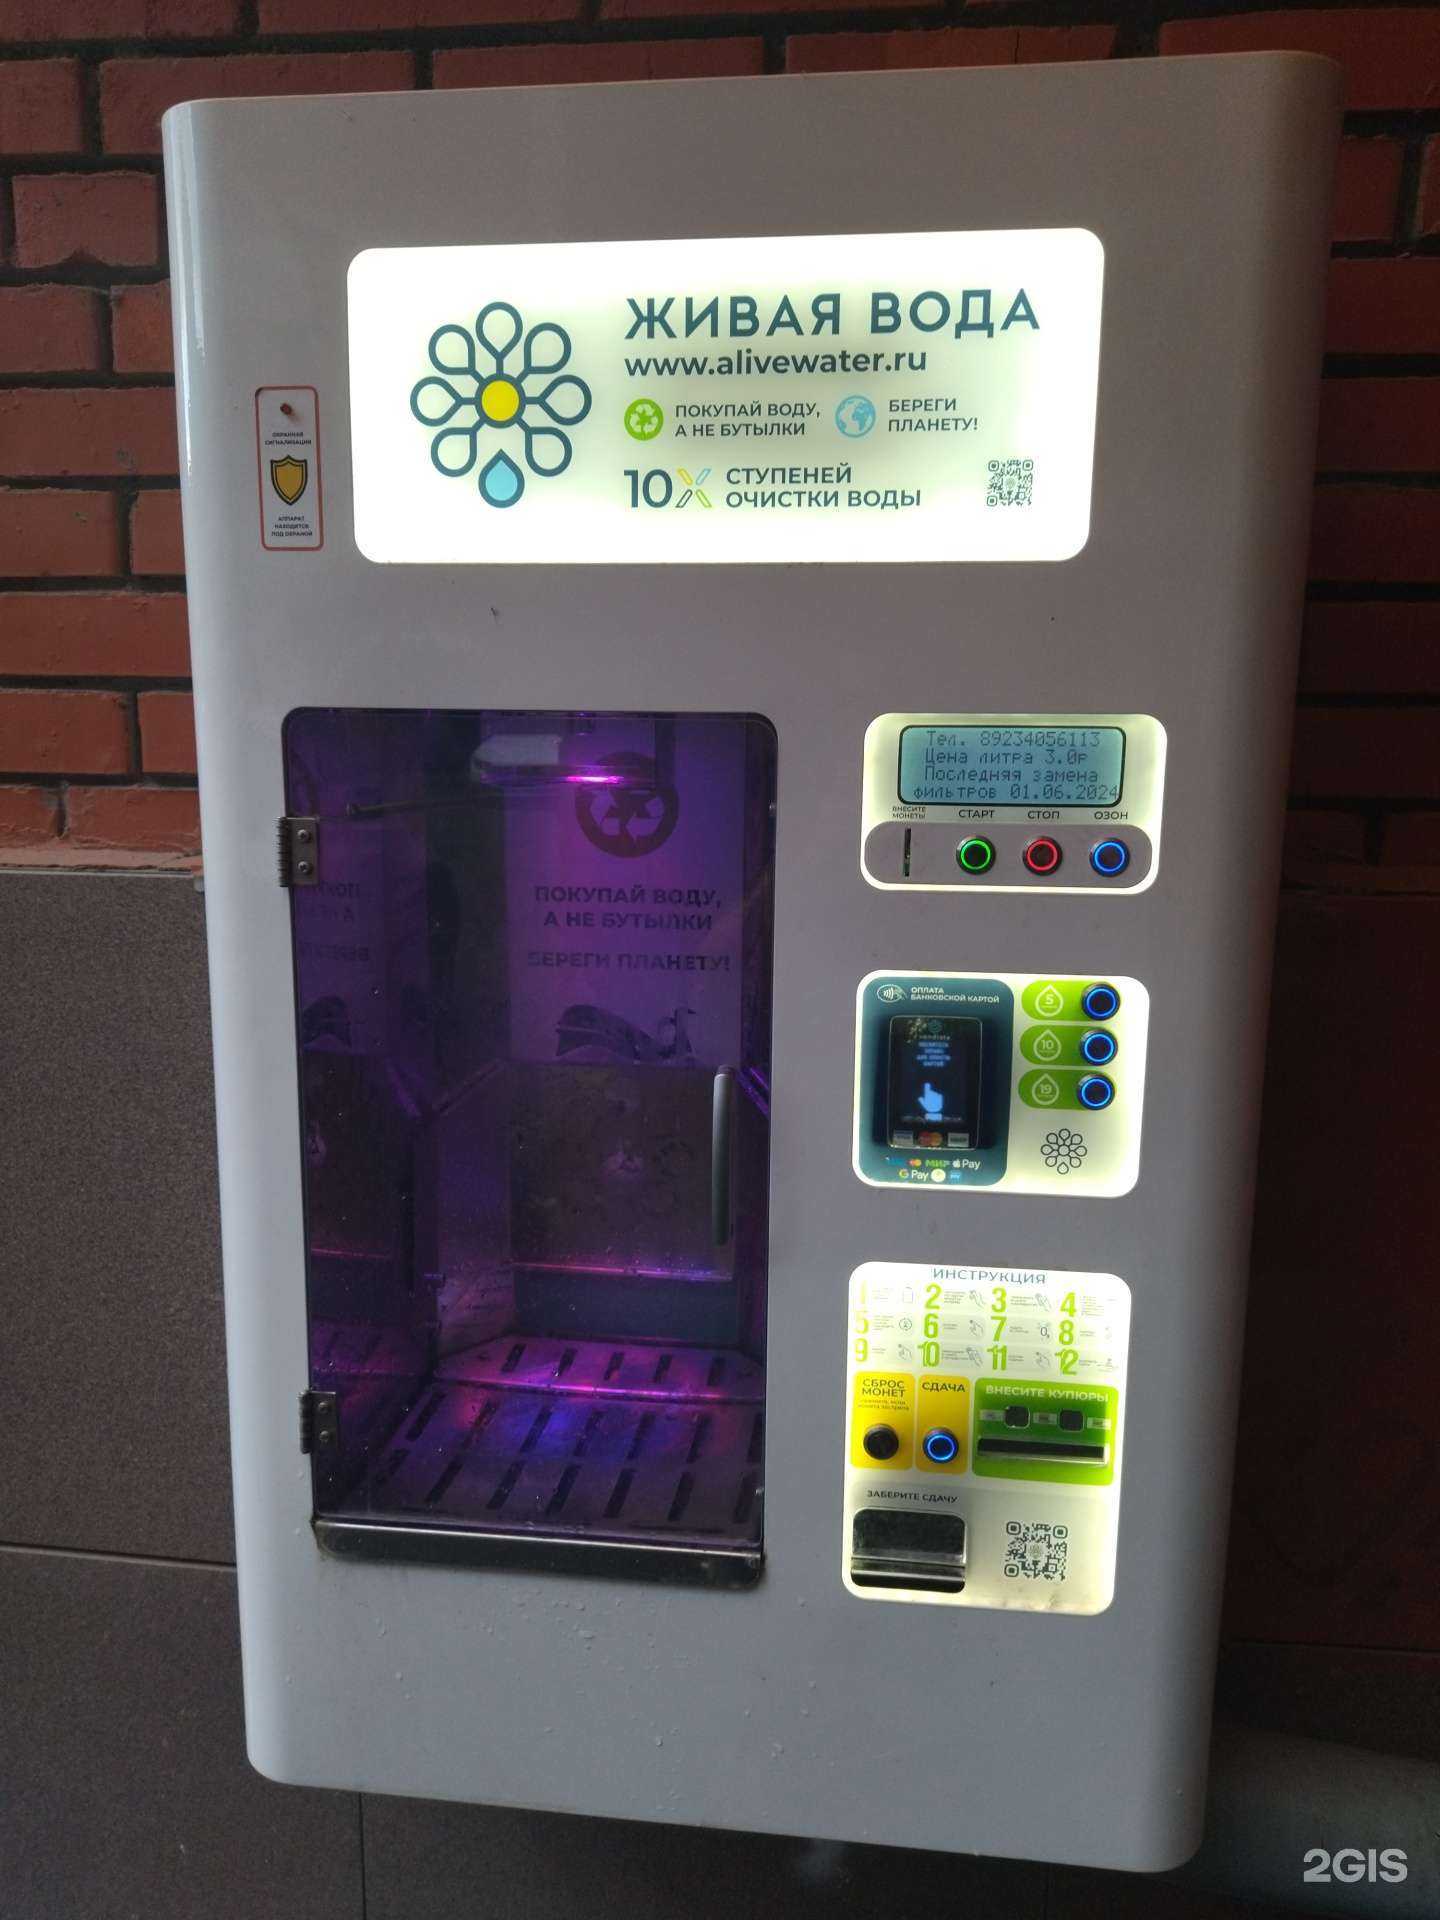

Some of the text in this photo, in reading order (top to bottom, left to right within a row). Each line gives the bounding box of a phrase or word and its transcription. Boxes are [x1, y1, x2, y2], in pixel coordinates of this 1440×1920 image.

[624, 287, 1040, 340] ЖИВАЯ ВОДА
[624, 347, 927, 377] www.alivewater.ru
[675, 400, 820, 419] ПОКУПАЙ ВОДУ,
[889, 398, 957, 413] БЕРЕГИ
[675, 422, 806, 438] А НЕ БУТЫЛКИ
[888, 417, 978, 433] ПЛАНЕТУ!
[726, 463, 852, 485] СТУПЕНЕЙ
[726, 489, 922, 509] ОЧИСТКИ ВОДЫ
[927, 730, 1101, 748] Тел. 89234056113
[925, 749, 968, 765] Цена
[979, 751, 1033, 765] литра
[924, 766, 1098, 782] Последняя замена
[913, 785, 1118, 801] фильтров 01.06.2024
[958, 809, 995, 819] СТАРТ
[1027, 810, 1060, 820] СТОП
[1094, 811, 1129, 820] ОЗОН
[534, 884, 722, 909] ПОКУПАЙ ВОДУ,
[544, 910, 713, 931] А НЕ БУТЫЛКИ
[528, 950, 731, 972] БЕРЕГИ ПЛАНЕТУ!
[911, 986, 944, 994] ОПЛАТА
[910, 993, 1000, 1004] БАНКОВСКОЙ КАРТОЙ
[1041, 1039, 1054, 1050] 10
[962, 1159, 981, 1170] Pay
[911, 1169, 929, 1182] Pay
[933, 1267, 1046, 1285] ИНСТРУКЦИЯ
[925, 1282, 942, 1310] 2
[991, 1287, 1007, 1313] 3
[1061, 1291, 1077, 1318] 4
[924, 1313, 938, 1339] 6
[991, 1316, 1007, 1342] 7
[1059, 1320, 1074, 1345] 8
[918, 1340, 940, 1368] 10
[987, 1345, 1007, 1371] 11
[863, 1378, 905, 1389] СБРОС
[921, 1381, 966, 1393] СДАЧА
[862, 1387, 906, 1397] МОНЕТ
[985, 1384, 1109, 1402] ВНЕСИТЕ КУПЮРЫ
[867, 1489, 958, 1504] ЗАБЕРИТЕ СДАЧУ
